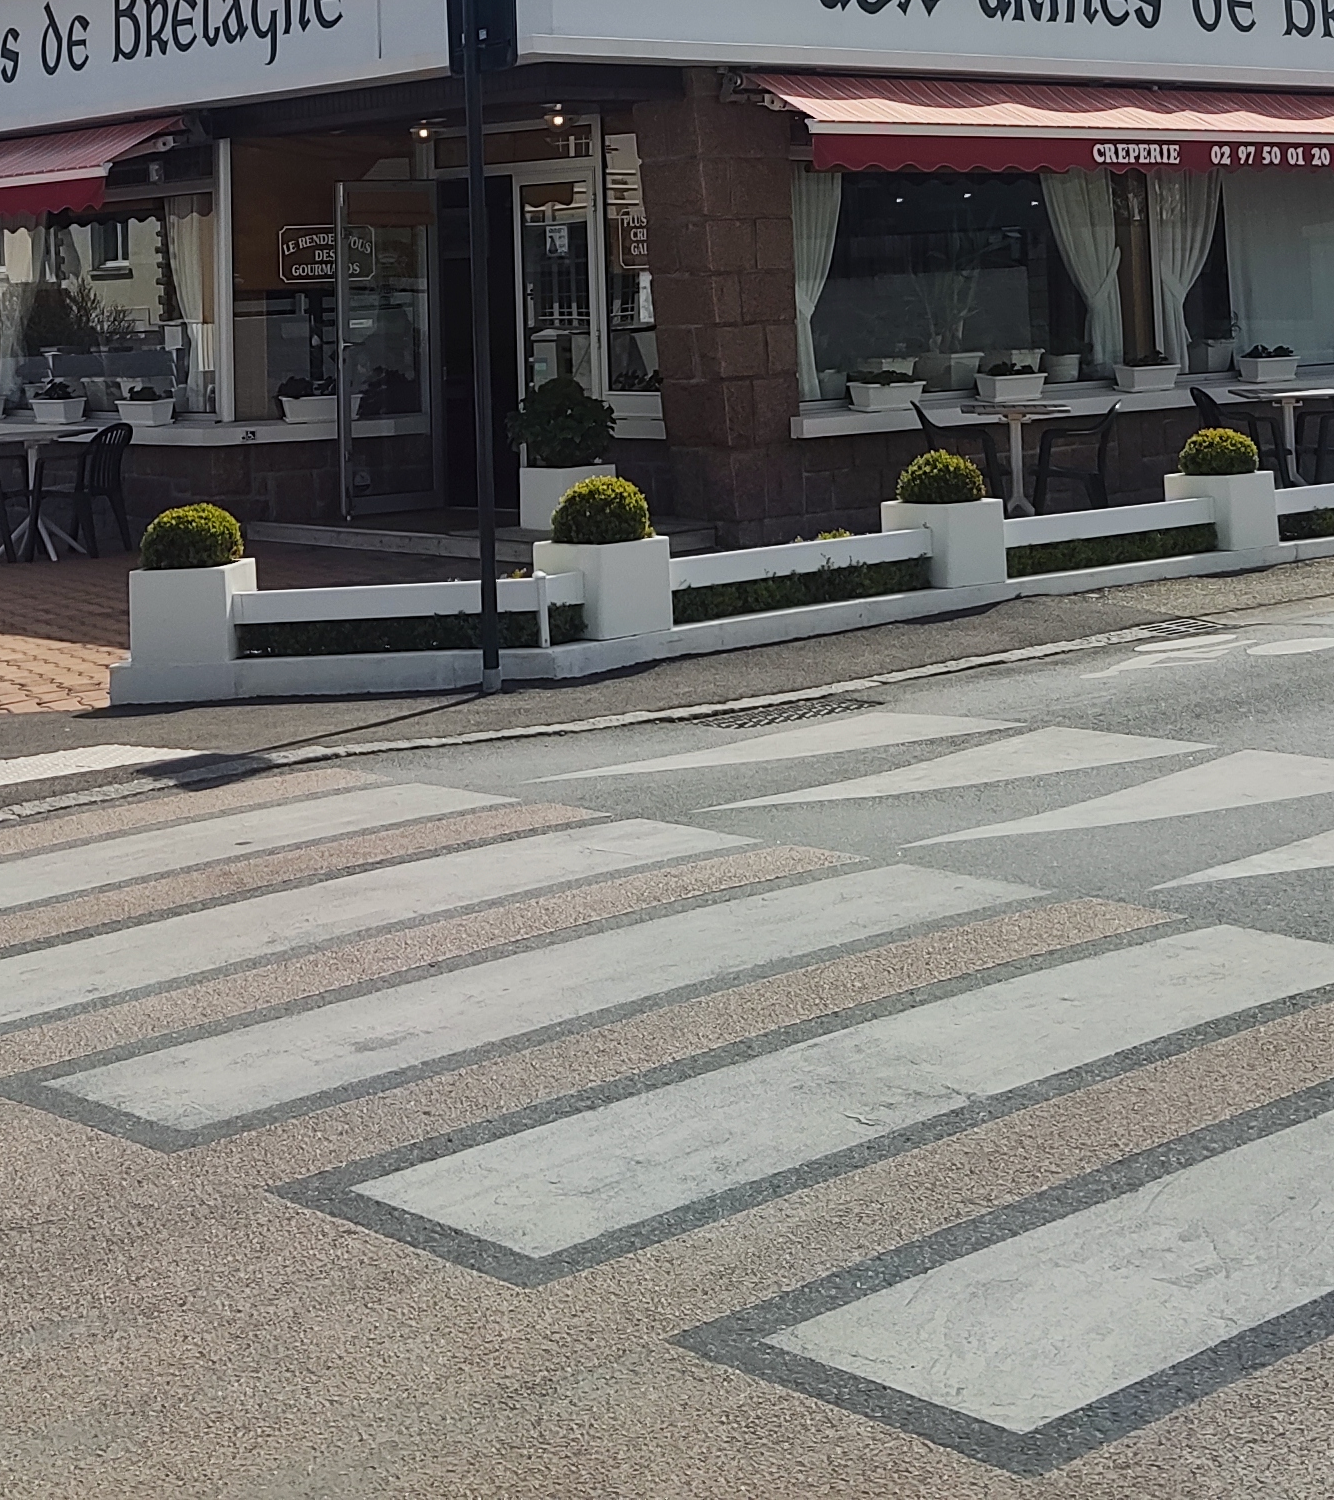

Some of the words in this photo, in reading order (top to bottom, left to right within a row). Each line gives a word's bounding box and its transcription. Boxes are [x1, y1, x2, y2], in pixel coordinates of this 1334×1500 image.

[1093, 143, 1180, 164] CREPERIE
[1210, 145, 1231, 165] 02
[1238, 145, 1255, 165] 97
[1261, 146, 1281, 165] 50
[1287, 147, 1305, 165] 01
[1311, 147, 1330, 166] 20
[283, 240, 298, 255] LE
[315, 250, 335, 261] DES
[292, 263, 360, 276] GOURMAS
